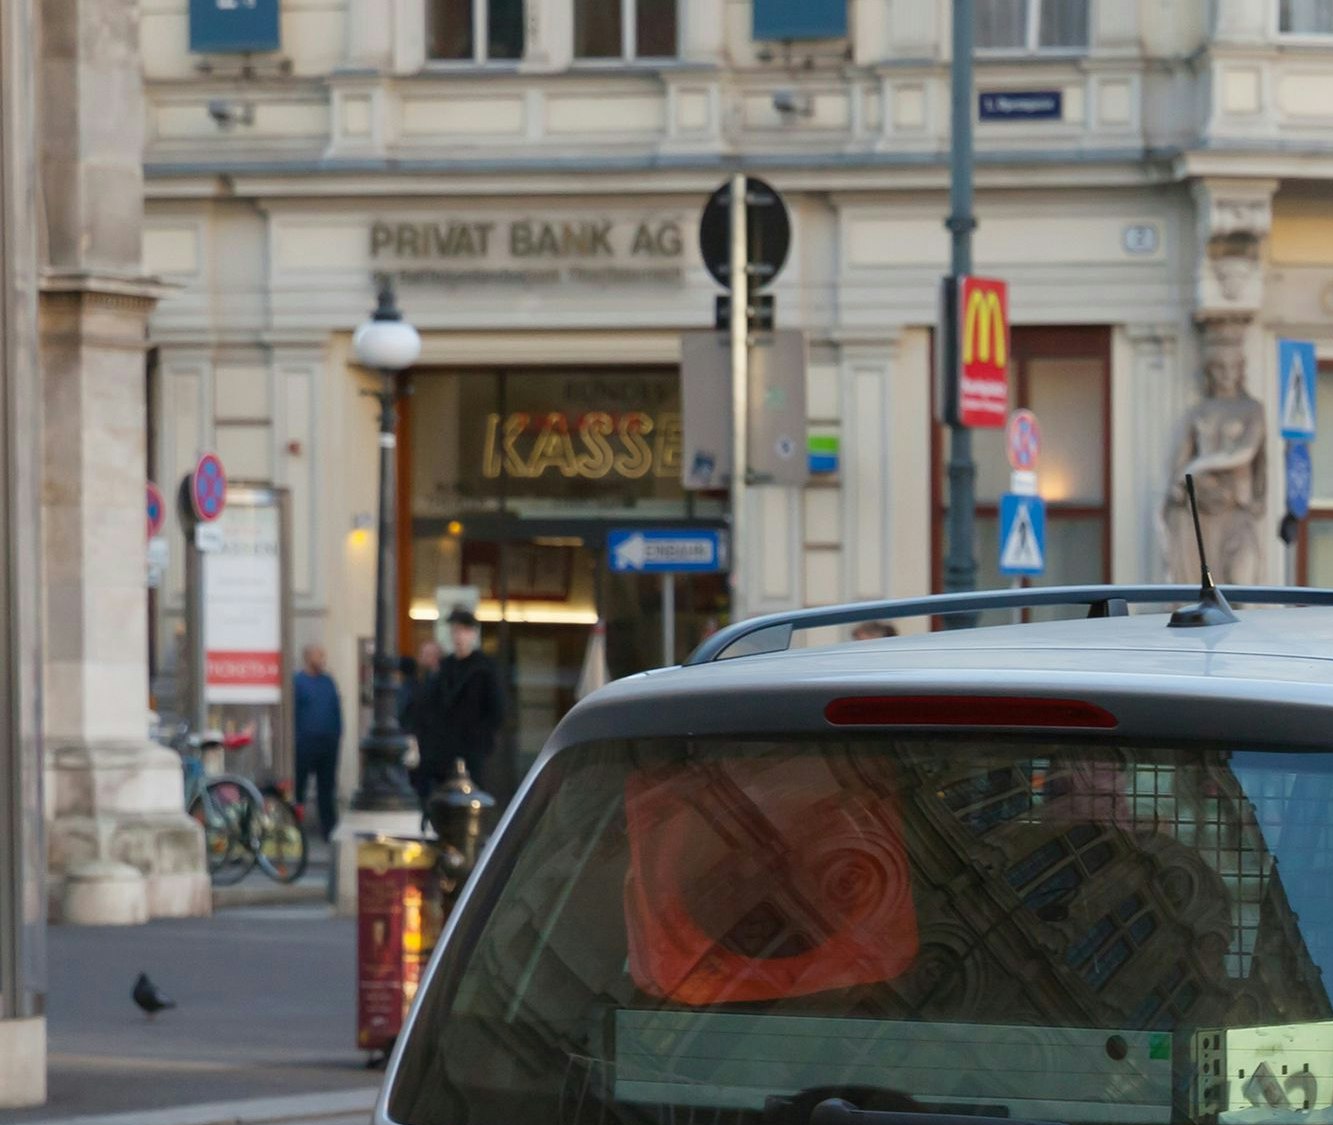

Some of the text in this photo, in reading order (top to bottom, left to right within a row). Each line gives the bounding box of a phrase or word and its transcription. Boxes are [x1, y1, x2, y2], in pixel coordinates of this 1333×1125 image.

[371, 220, 684, 257] PRIVAT BANK AG
